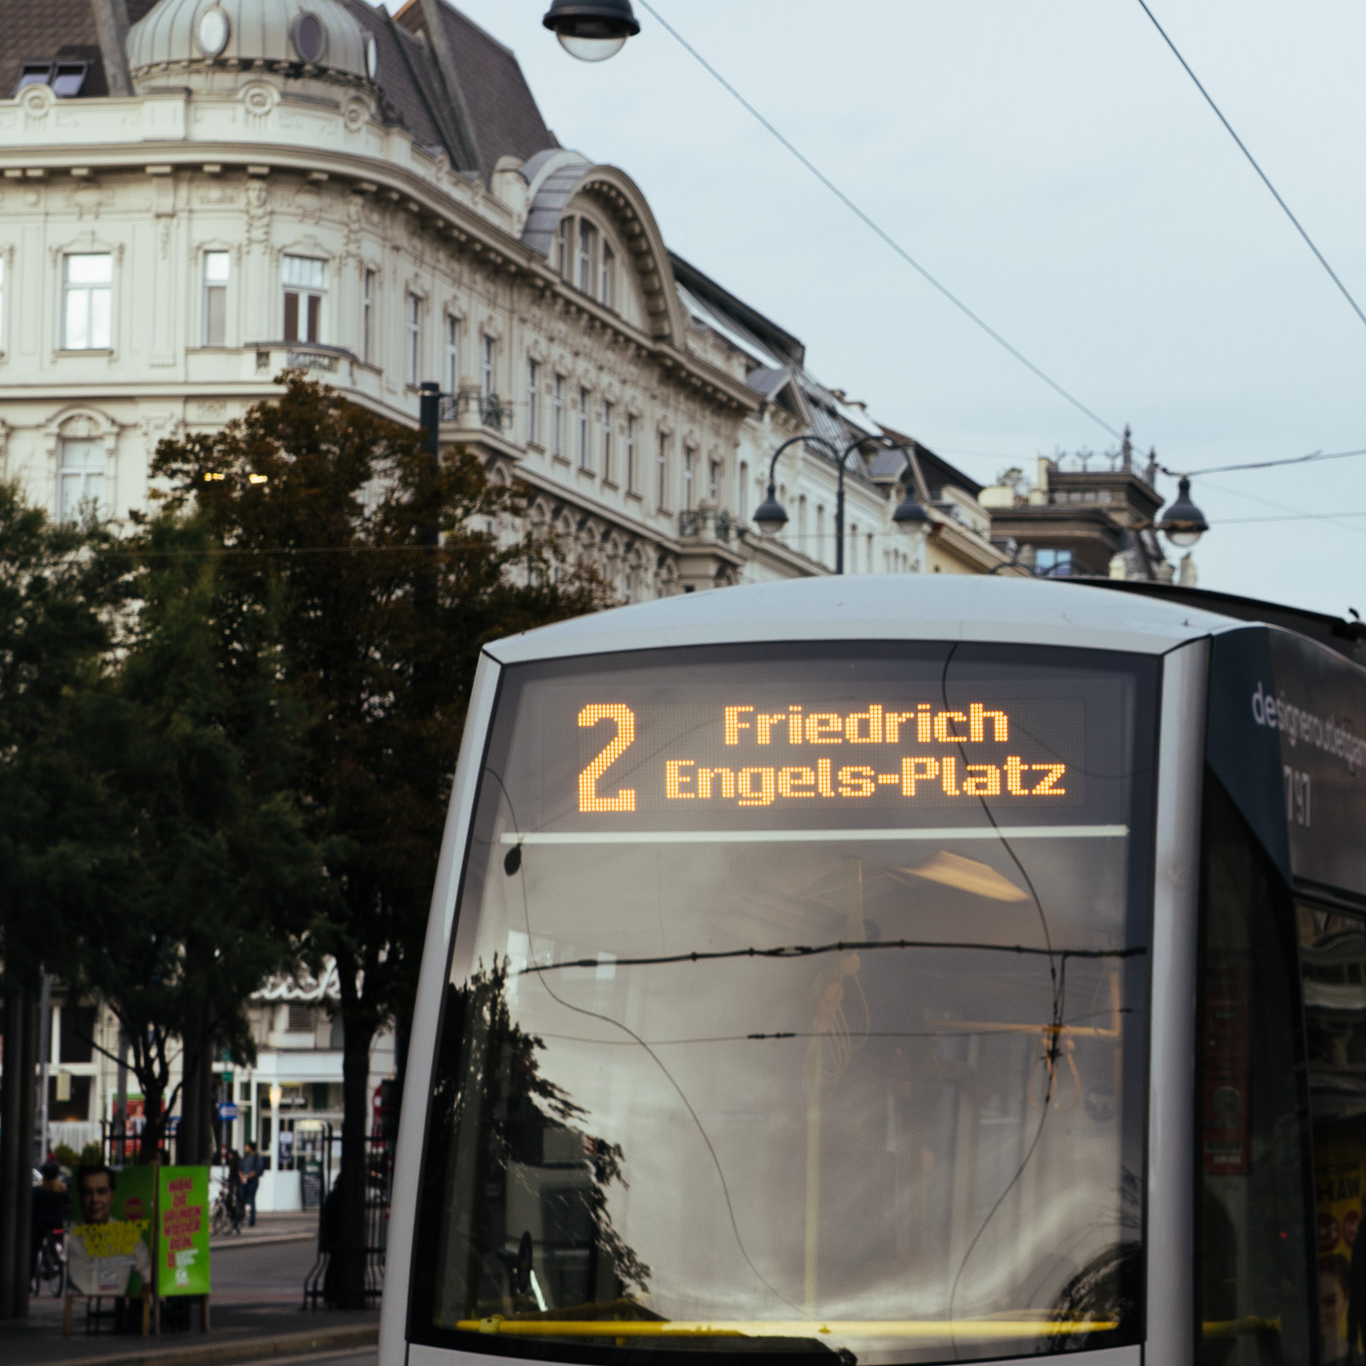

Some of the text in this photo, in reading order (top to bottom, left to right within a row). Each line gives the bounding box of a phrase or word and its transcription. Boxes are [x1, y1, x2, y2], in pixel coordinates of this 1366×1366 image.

[724, 702, 1010, 746] Friedrich
[579, 704, 636, 813] 2
[665, 756, 1066, 807] Engels-Platz
